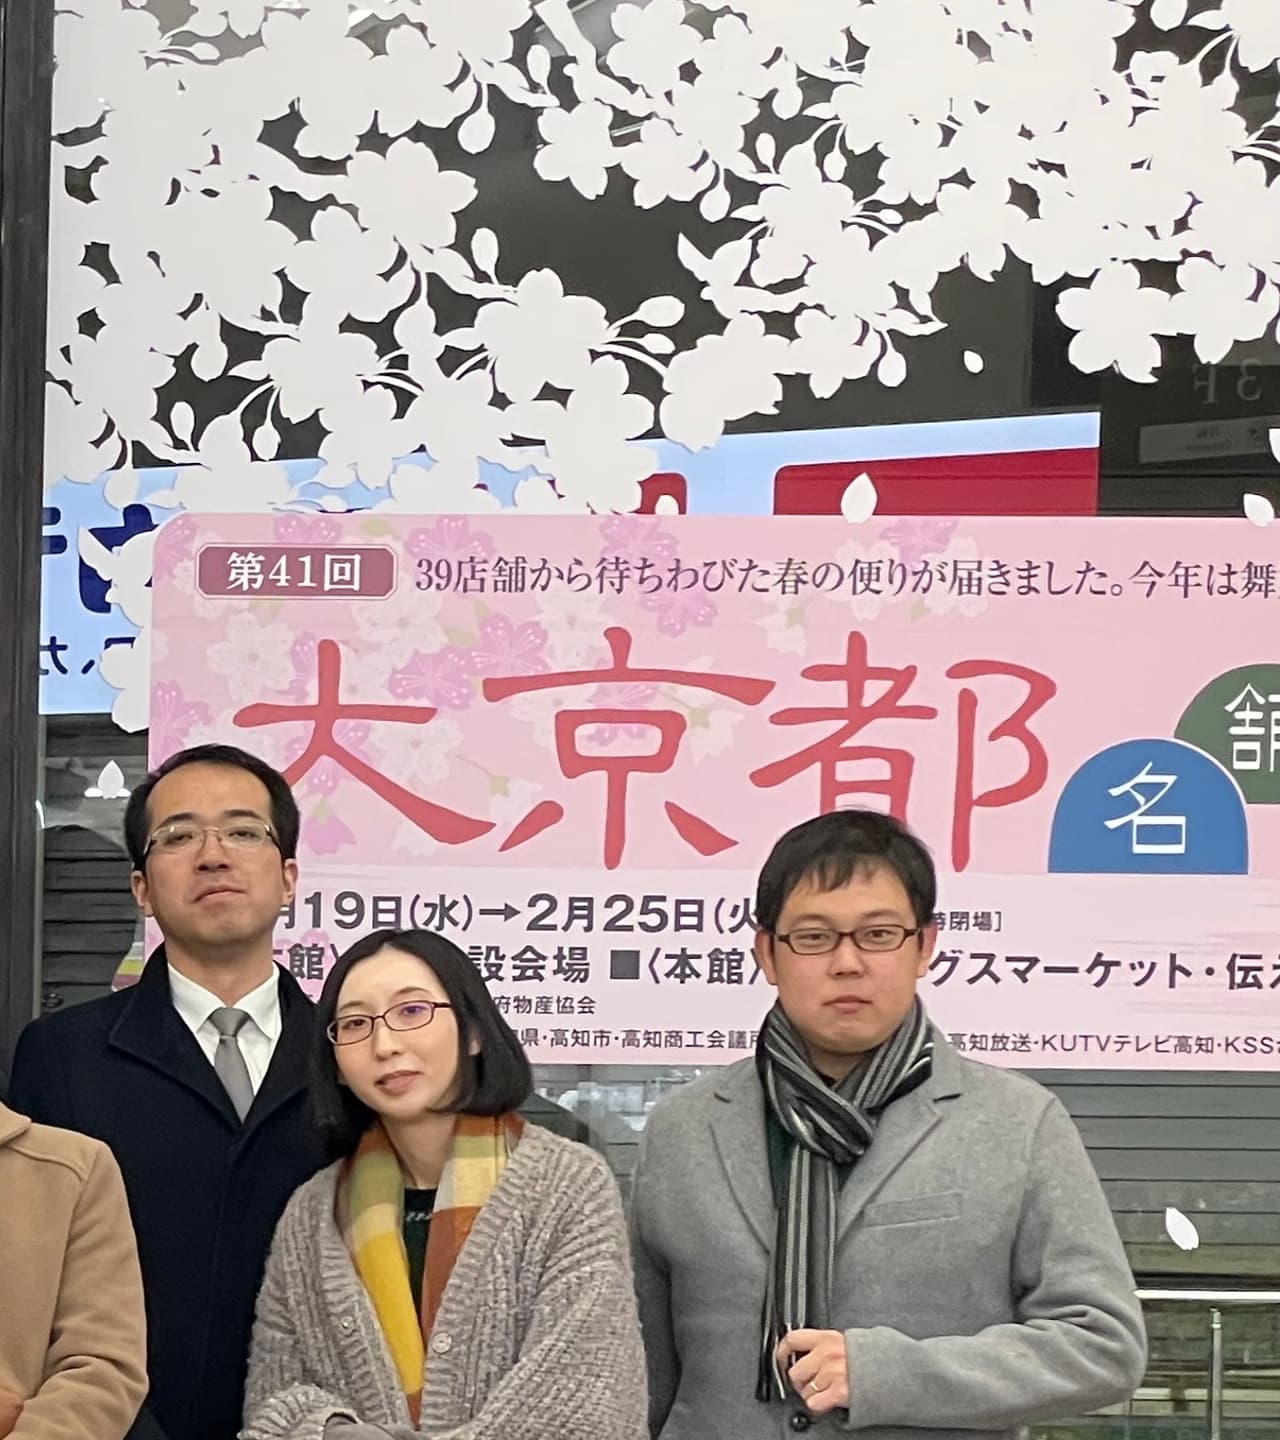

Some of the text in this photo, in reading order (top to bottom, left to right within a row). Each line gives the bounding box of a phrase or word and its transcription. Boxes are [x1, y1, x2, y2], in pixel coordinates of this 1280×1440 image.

[226, 551, 363, 591] 第41回
[231, 626, 1057, 872] 大京都
[1103, 761, 1187, 854] 名
